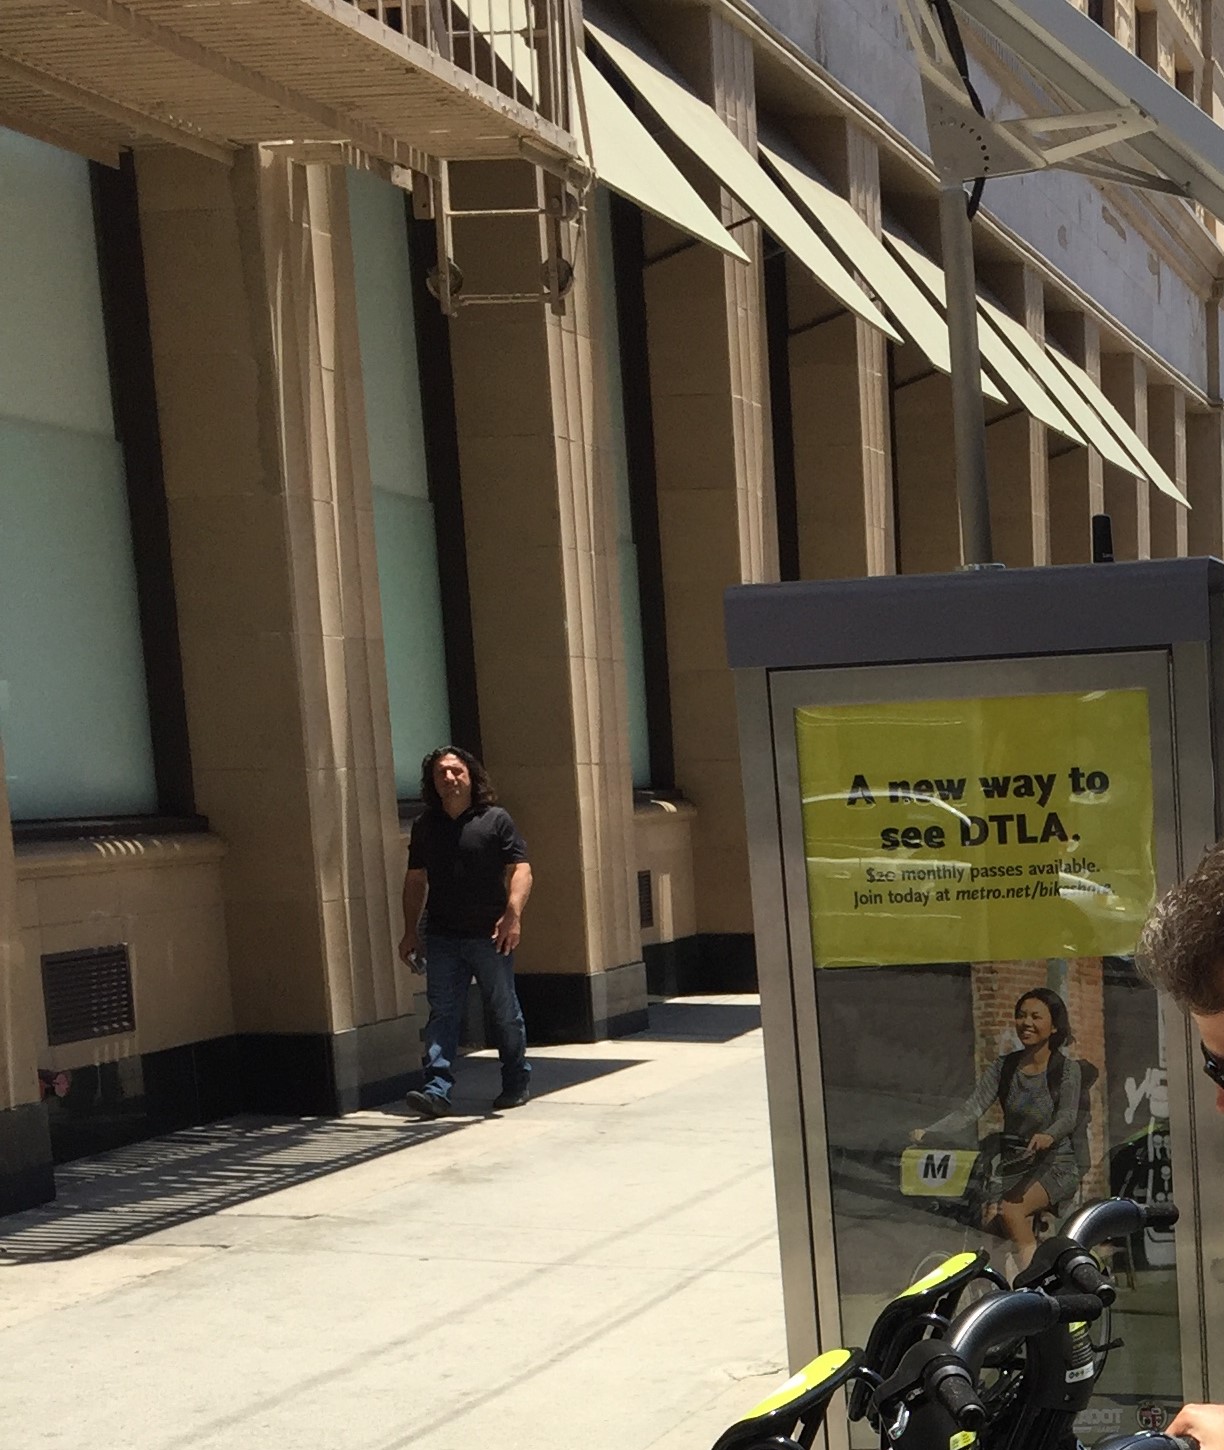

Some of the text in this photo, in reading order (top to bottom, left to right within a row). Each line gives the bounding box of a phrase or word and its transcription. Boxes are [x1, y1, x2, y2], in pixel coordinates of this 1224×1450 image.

[847, 767, 1110, 808] A new way to
[881, 812, 1081, 850] see DTLA.
[901, 862, 966, 884] monthly
[970, 863, 1023, 881] passes
[1029, 857, 1101, 876] available.
[853, 890, 882, 909] Join
[888, 888, 931, 907] today
[936, 888, 951, 902] at
[922, 1154, 949, 1182] M
